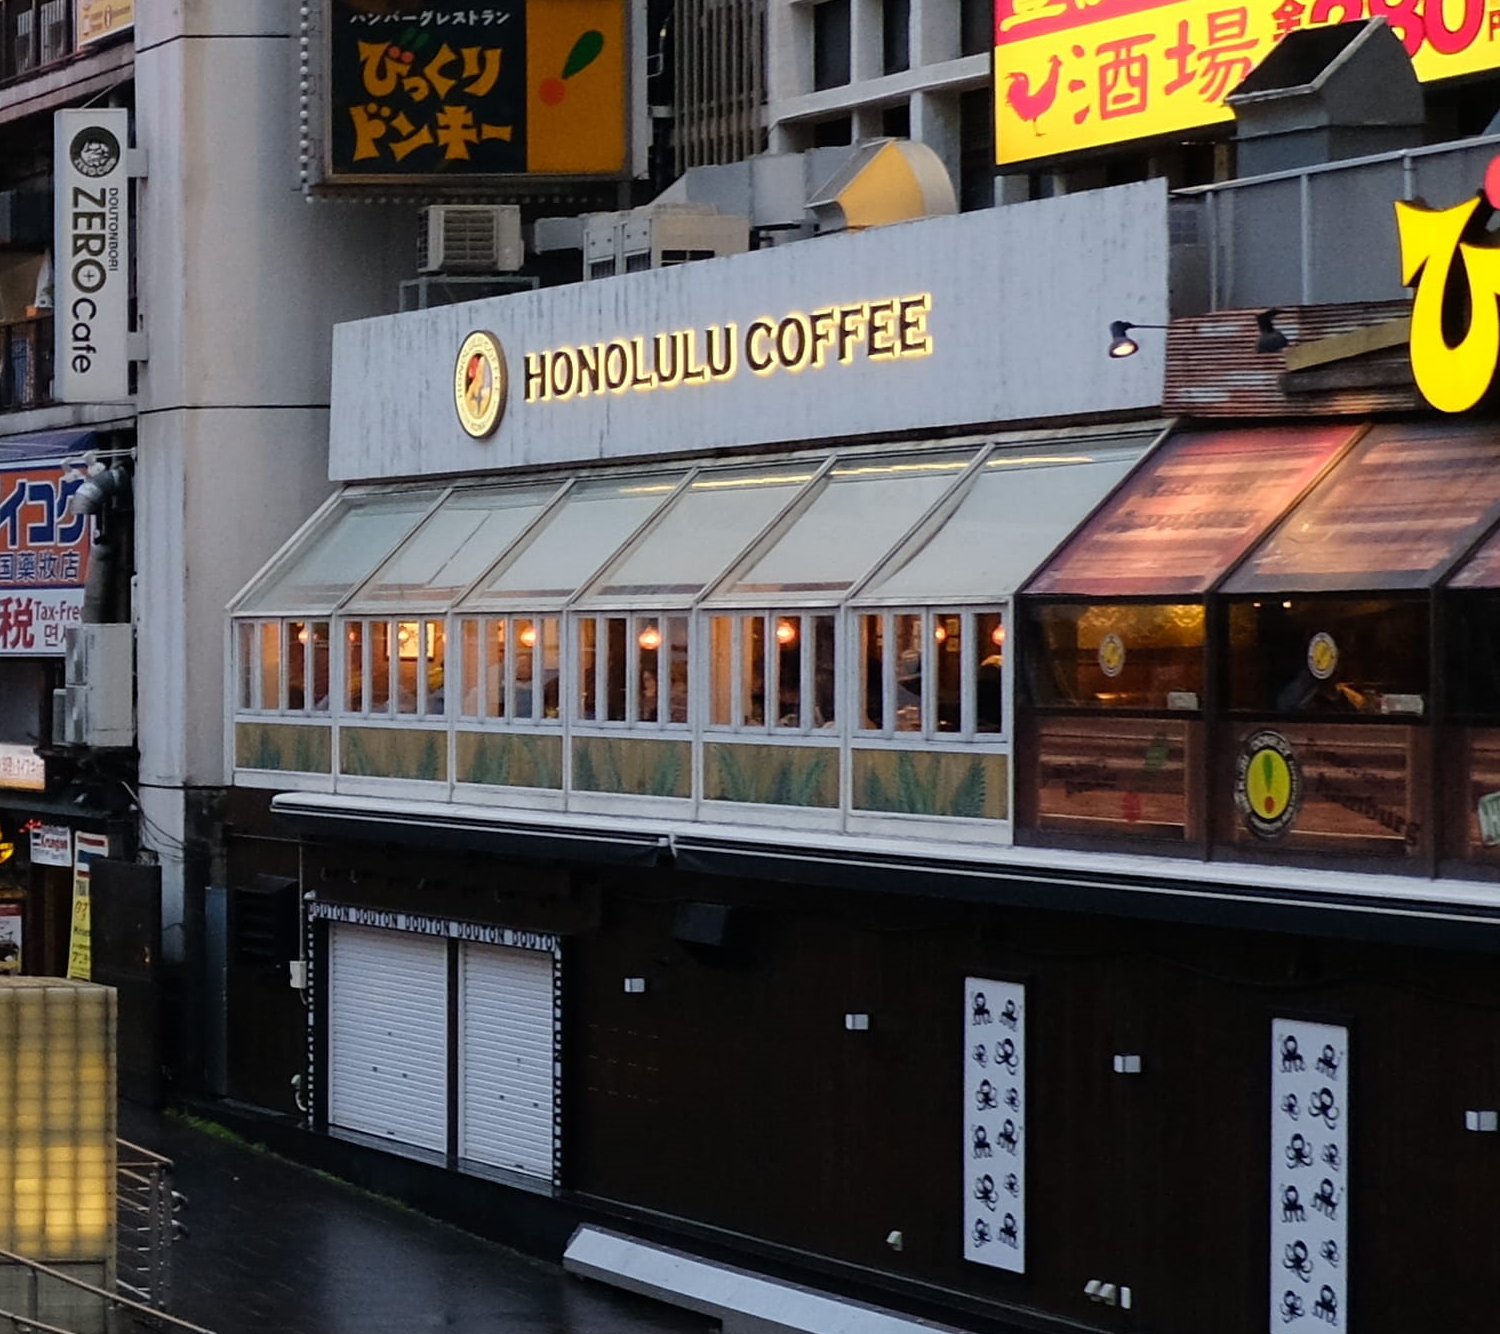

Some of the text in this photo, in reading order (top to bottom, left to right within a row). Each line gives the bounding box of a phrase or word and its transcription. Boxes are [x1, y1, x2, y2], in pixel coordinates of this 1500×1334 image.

[348, 9, 511, 27] ハンバーグレストラン
[356, 38, 503, 102] びっくり
[1068, 7, 1260, 127] 酒場
[349, 104, 513, 163] ドンキー
[108, 187, 119, 273] DOUTONBORI
[71, 186, 107, 375] ZERO Cafe
[522, 292, 933, 403] HONOLULU COFFEE
